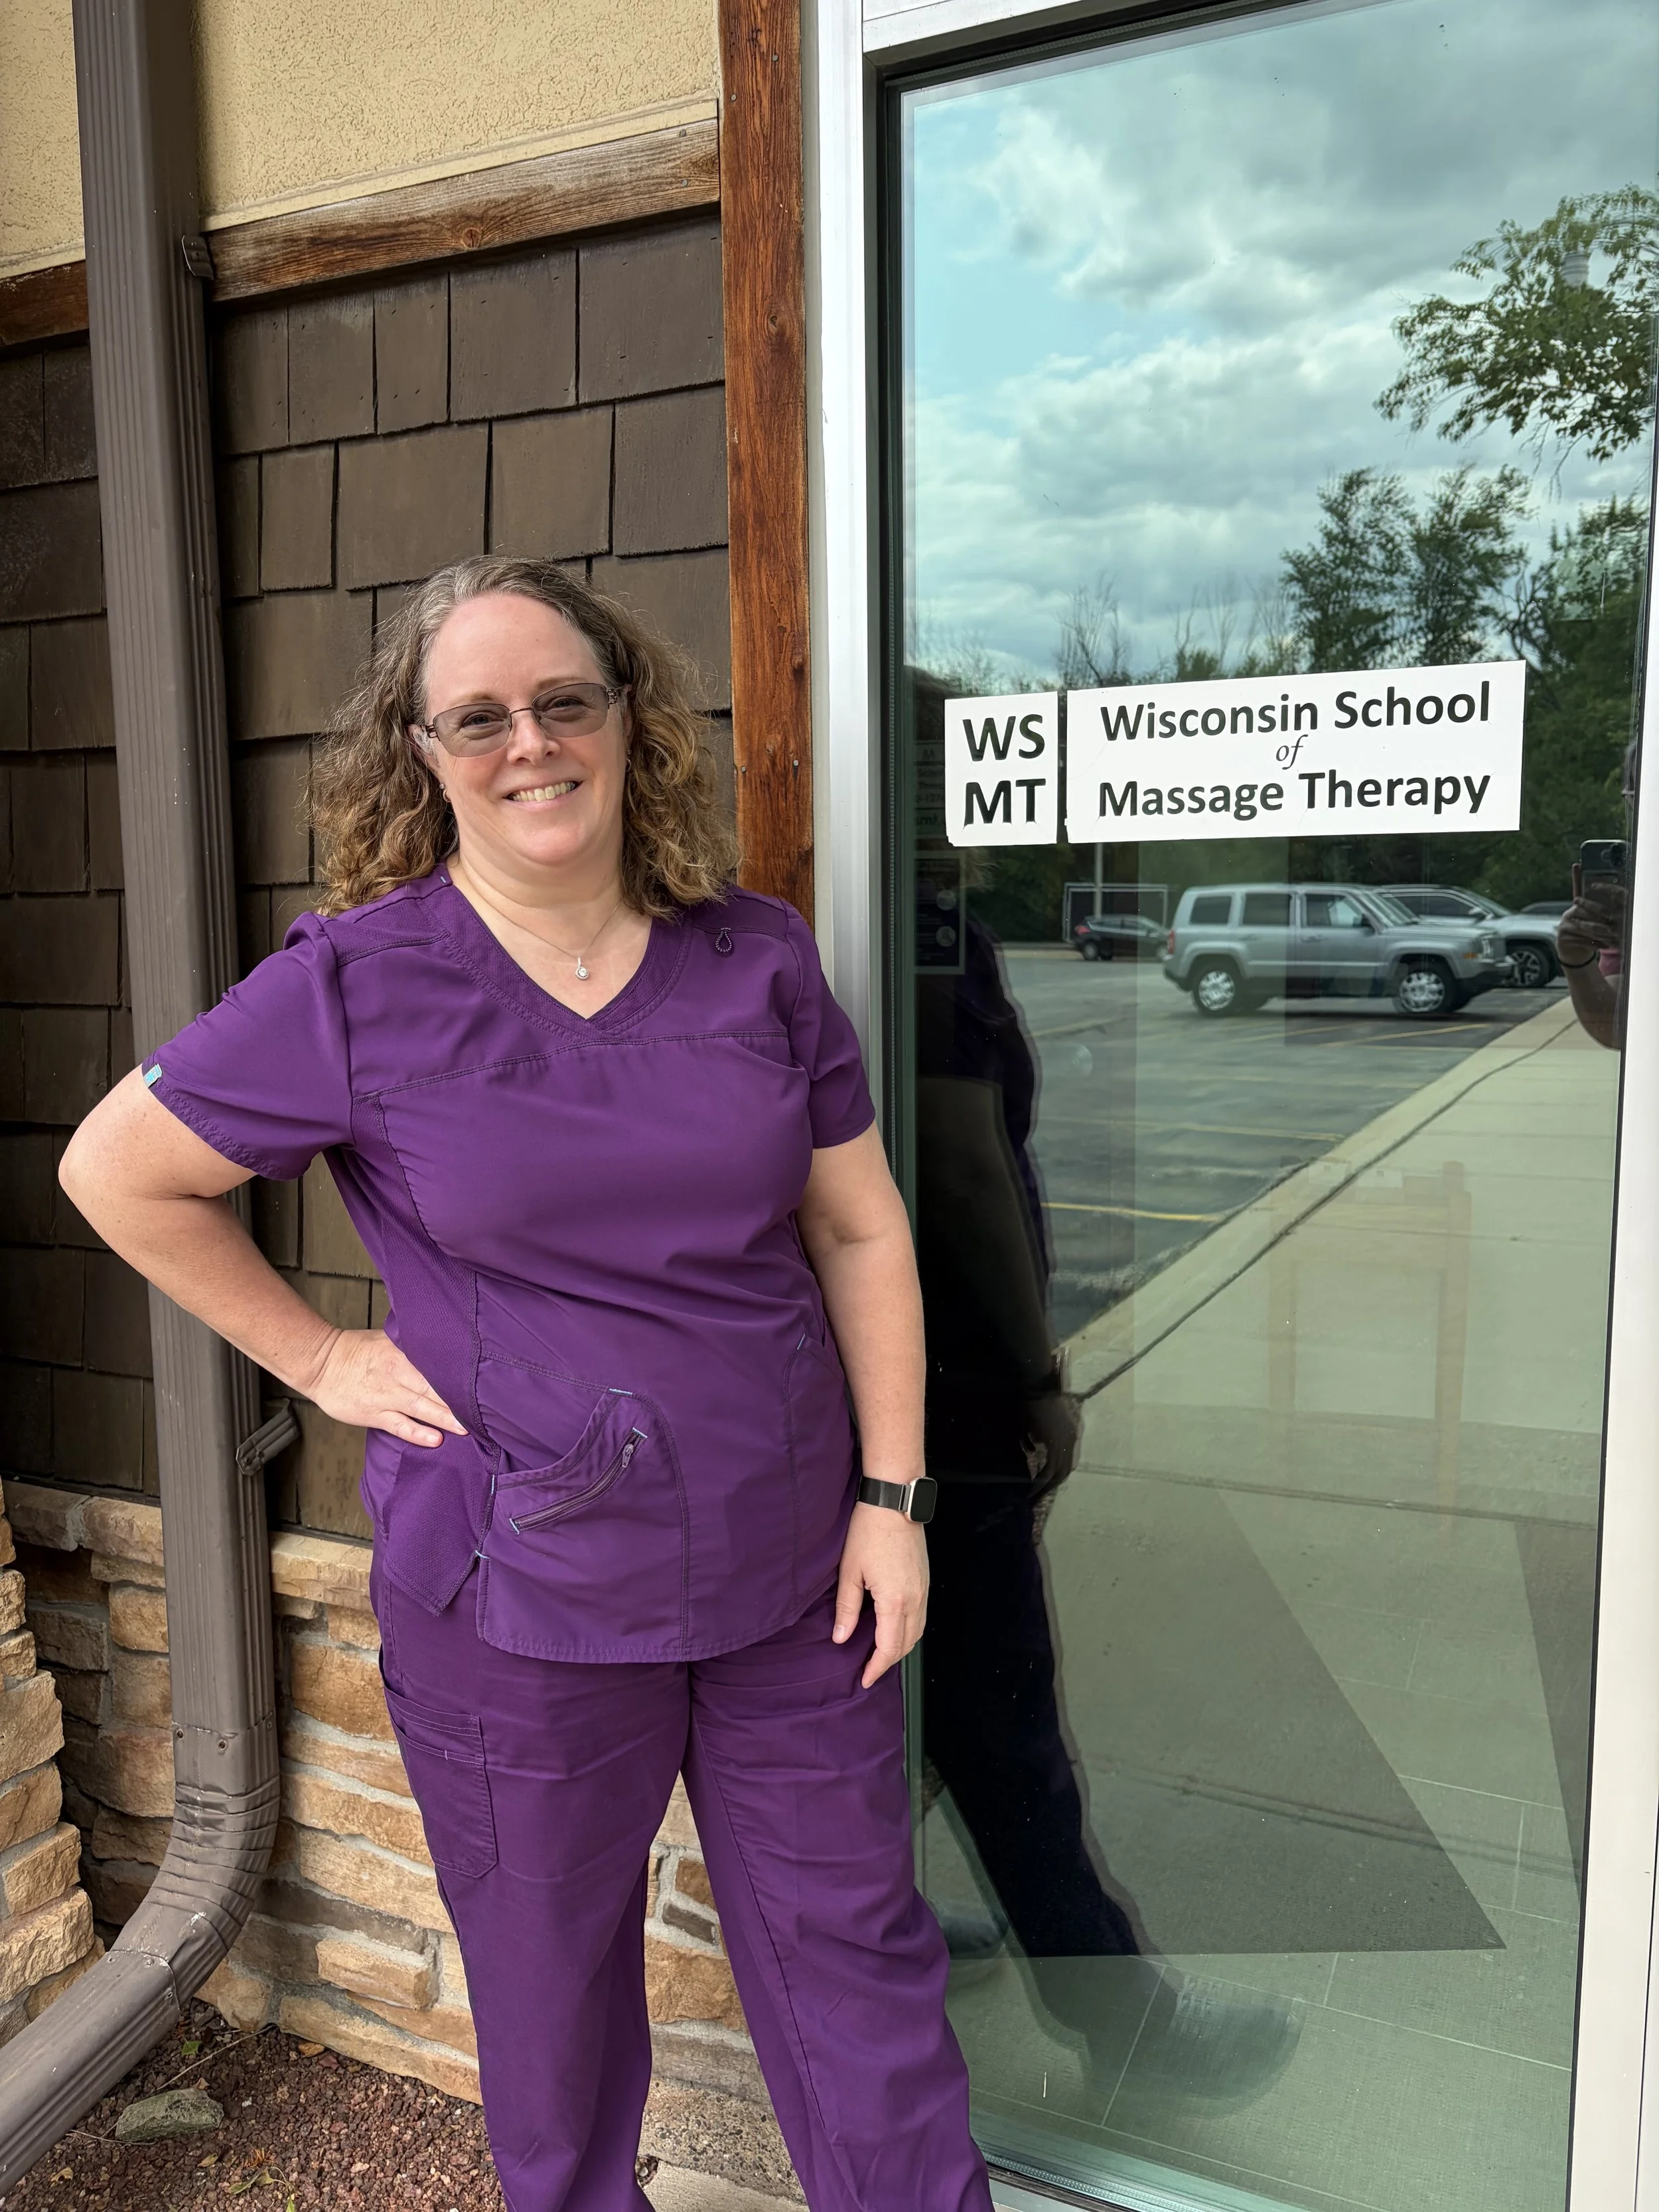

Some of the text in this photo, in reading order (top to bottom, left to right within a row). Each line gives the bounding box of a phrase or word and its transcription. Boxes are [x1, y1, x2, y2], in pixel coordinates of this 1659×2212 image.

[1100, 680, 1490, 741] Wisconsin School
[962, 713, 1045, 762] WS
[1275, 734, 1309, 771] of
[964, 778, 1046, 827] MT
[1099, 769, 1491, 821] Massage Therapy
